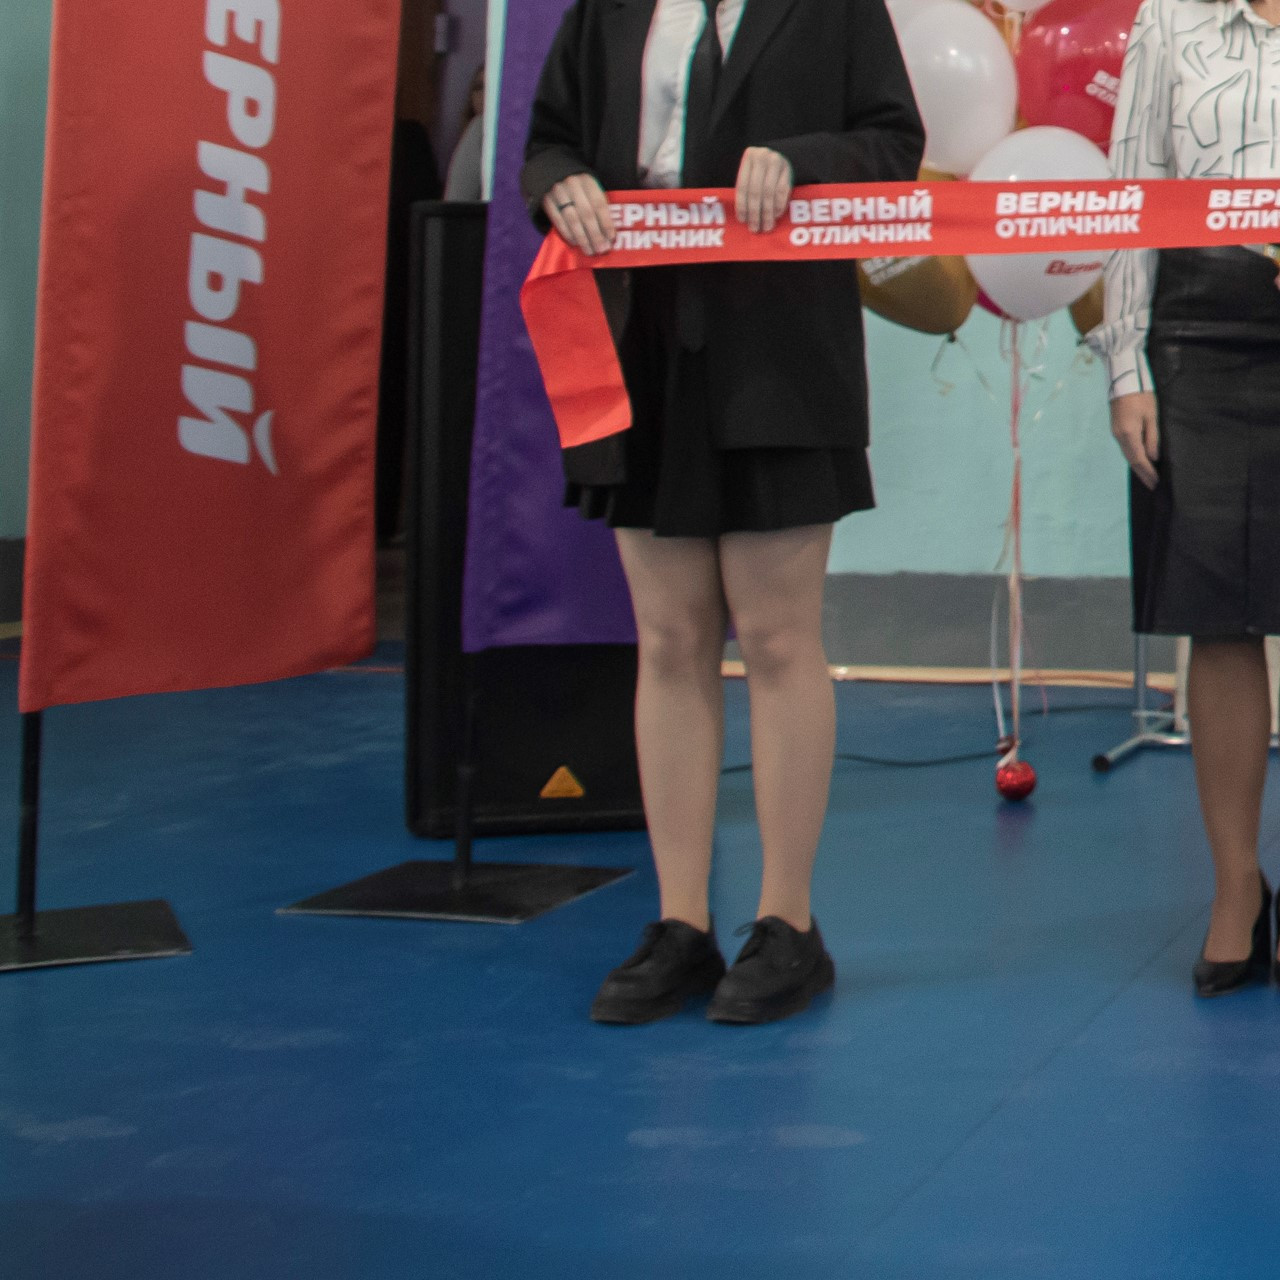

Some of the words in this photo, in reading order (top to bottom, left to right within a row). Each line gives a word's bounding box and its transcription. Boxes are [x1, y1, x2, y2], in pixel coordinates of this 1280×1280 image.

[609, 196, 726, 227] ЕРНЫЙ
[789, 189, 933, 225] ВЕРНЫЙ
[995, 185, 1145, 215] ВЕРНЫЙ
[613, 227, 725, 251] ЛИЧНИК
[788, 222, 933, 247] ОТЛИЧНИК
[994, 213, 1141, 239] ОТЛИЧНИК
